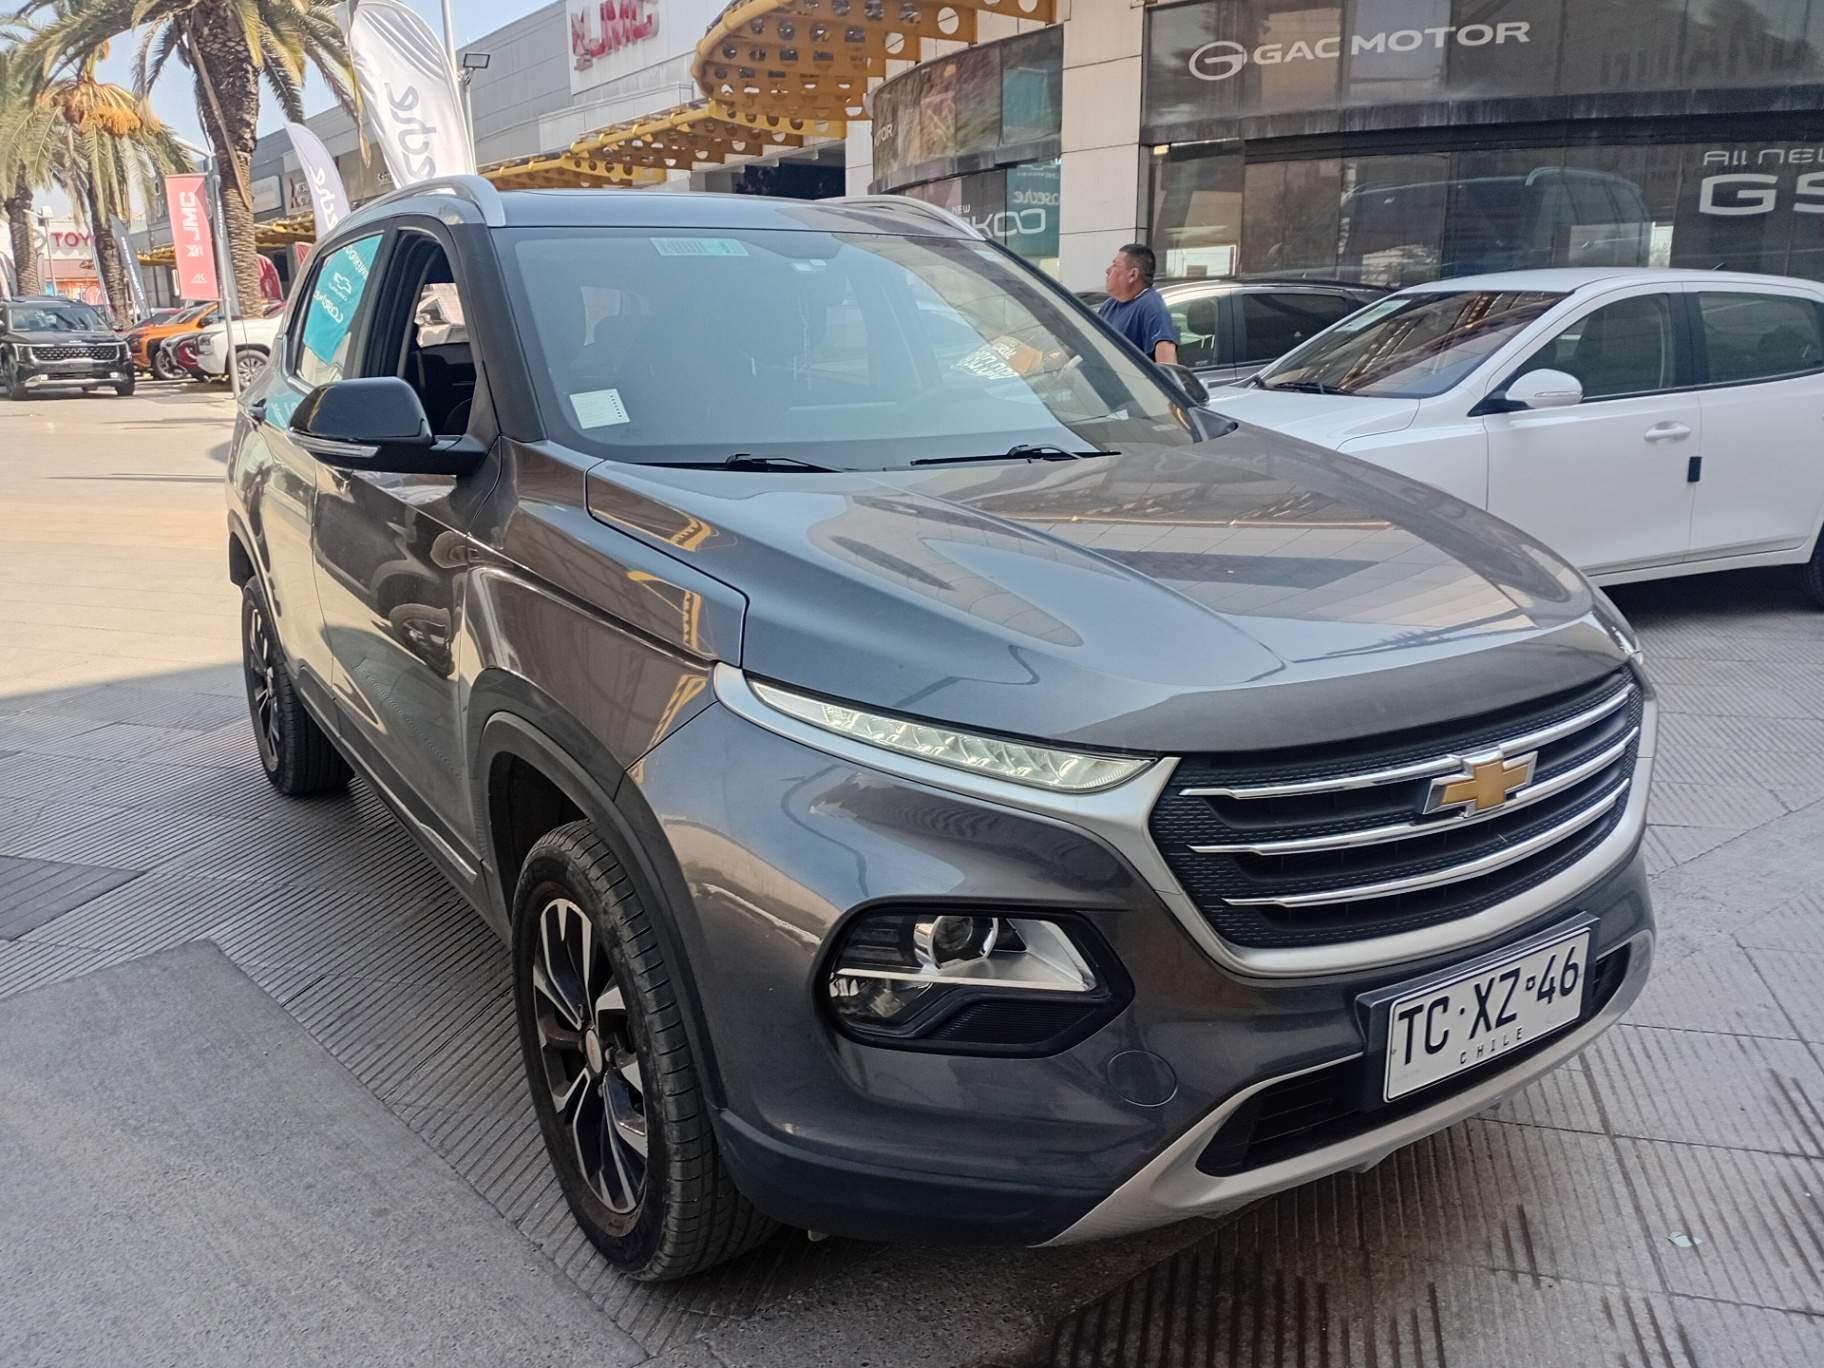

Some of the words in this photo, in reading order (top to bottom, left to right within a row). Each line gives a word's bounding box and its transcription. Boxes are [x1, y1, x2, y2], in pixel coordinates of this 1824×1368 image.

[589, 0, 658, 58] JMC
[1253, 36, 1342, 65] GAC
[1350, 21, 1531, 55] MOTOR
[179, 190, 201, 241] JMC
[1459, 1026, 1524, 1066] CHILE
